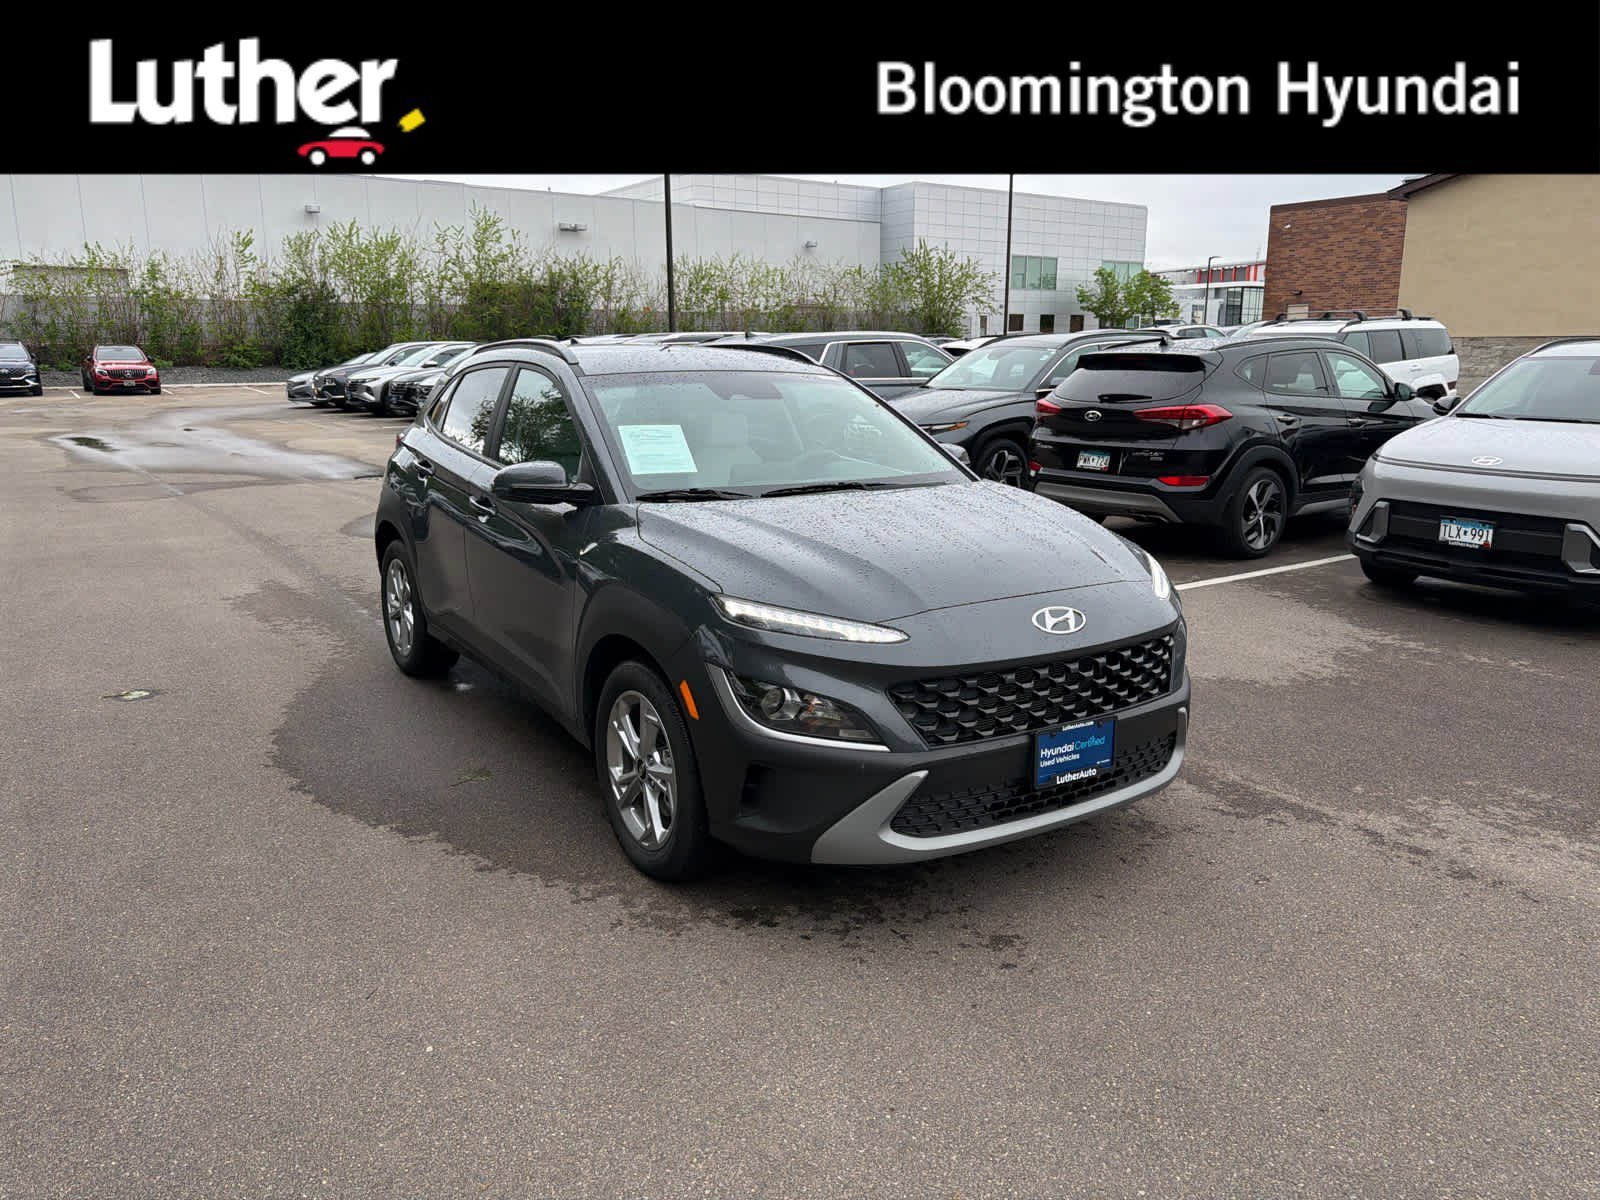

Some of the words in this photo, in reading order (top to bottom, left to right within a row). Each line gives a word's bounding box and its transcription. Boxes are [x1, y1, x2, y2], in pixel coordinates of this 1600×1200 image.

[1040, 758, 1056, 768] Used
[1056, 753, 1080, 764] Vehicles
[1056, 767, 1097, 785] LutherAuto
